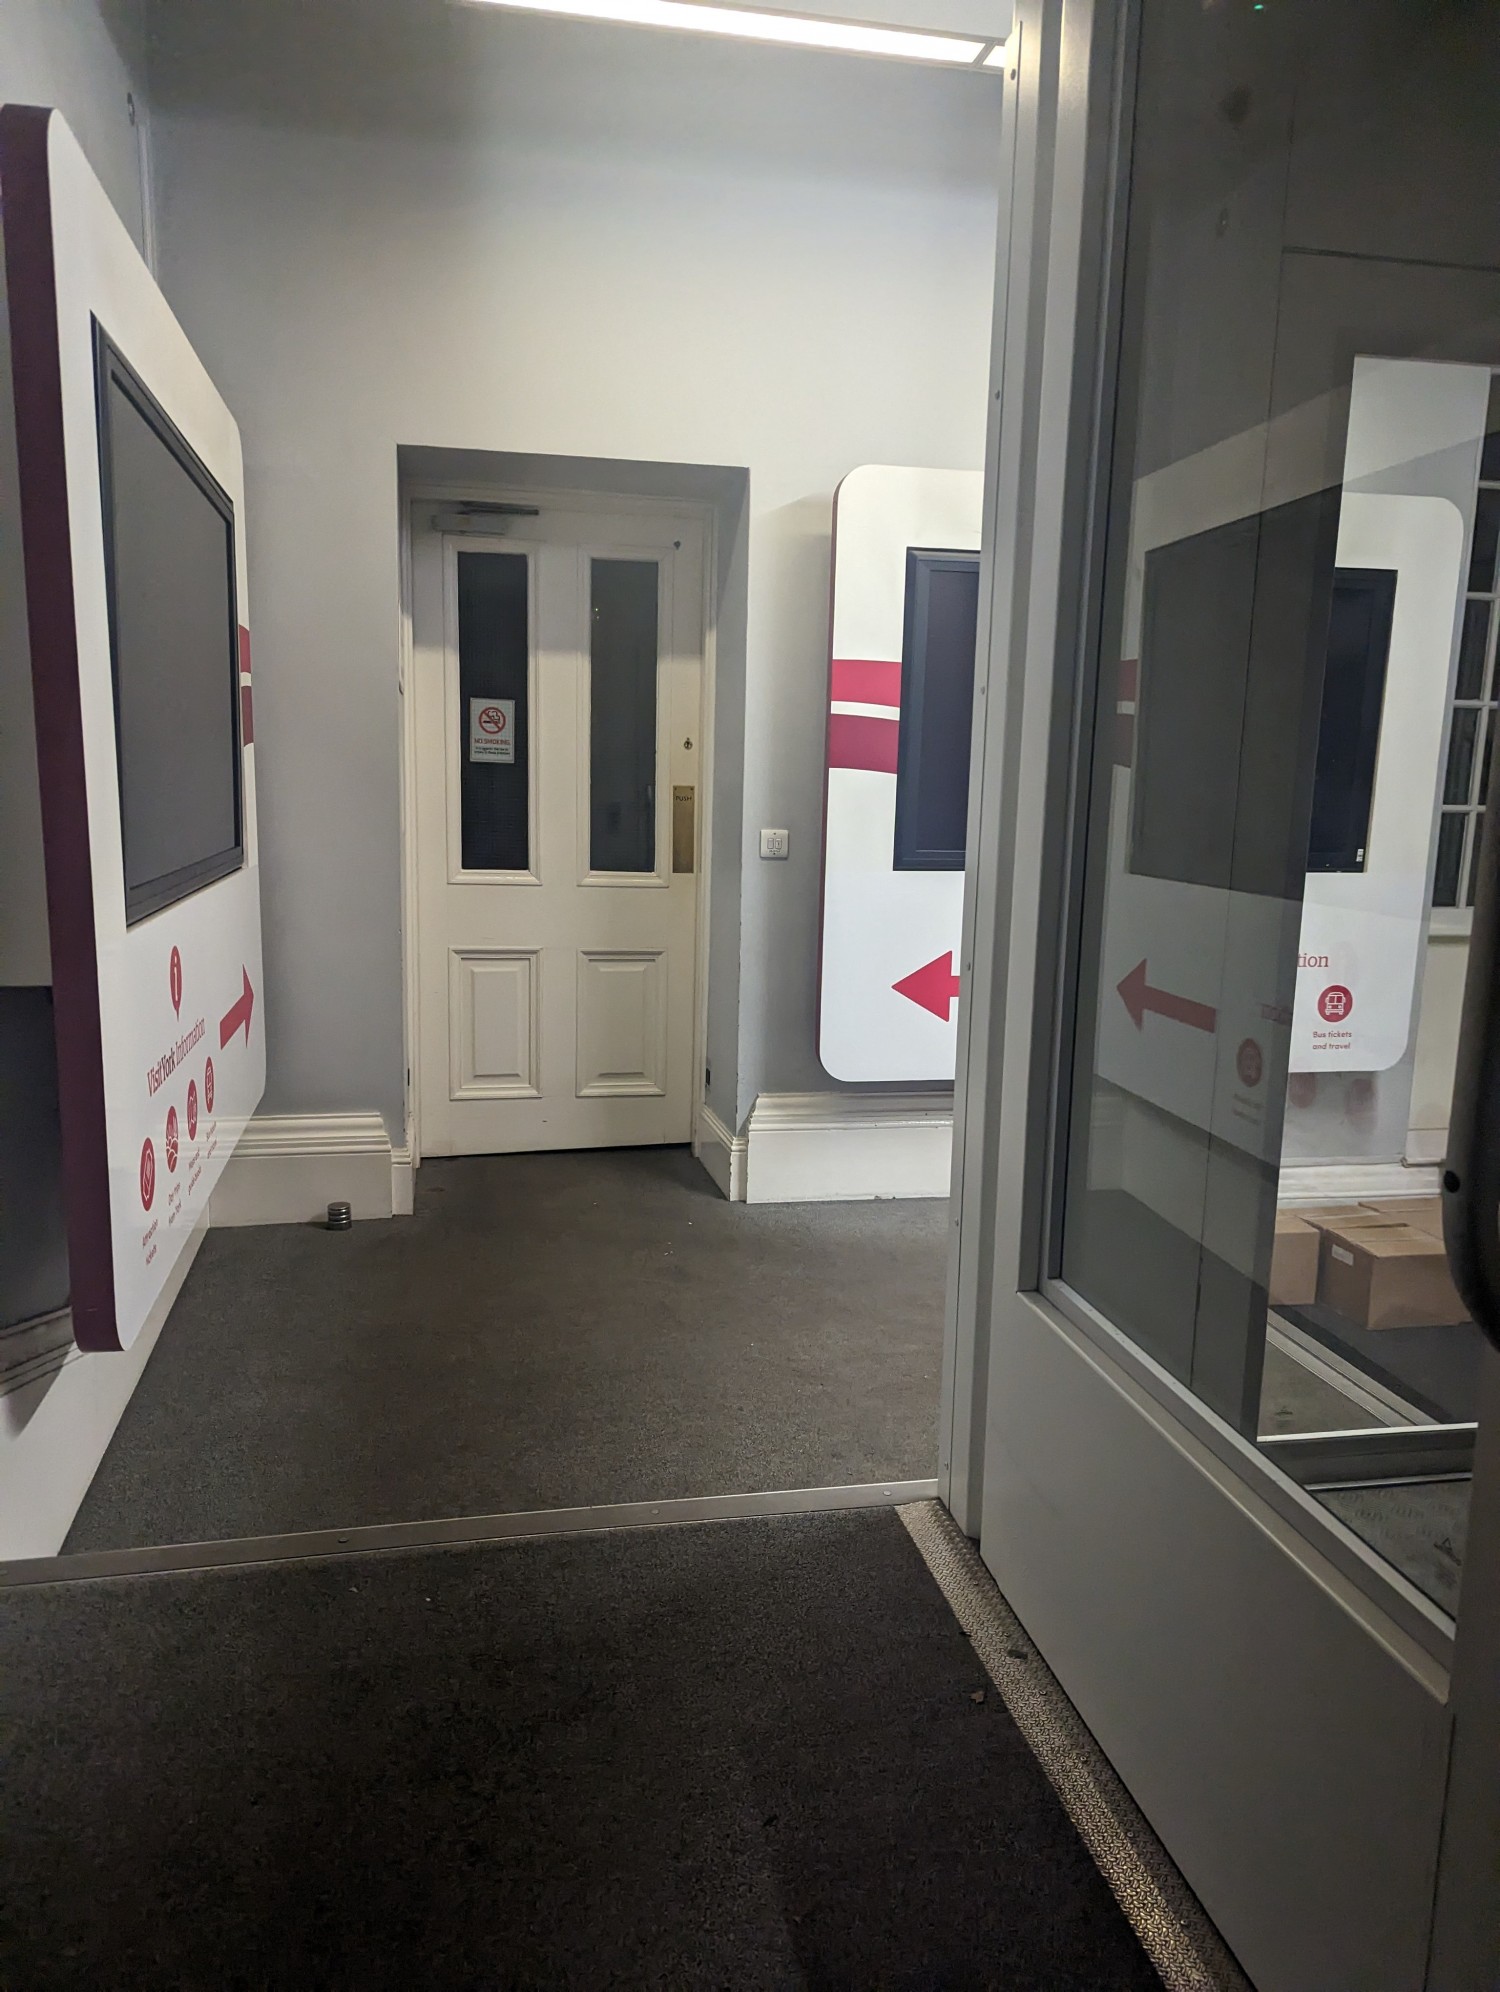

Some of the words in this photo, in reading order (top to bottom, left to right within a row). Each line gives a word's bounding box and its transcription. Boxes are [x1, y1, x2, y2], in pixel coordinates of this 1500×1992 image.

[1312, 1031, 1326, 1039] Bus
[1328, 1030, 1353, 1039] tickets
[1329, 1042, 1351, 1050] travel
[147, 1061, 162, 1097] Visit
[161, 1047, 176, 1082] York
[175, 1018, 206, 1067] Information
